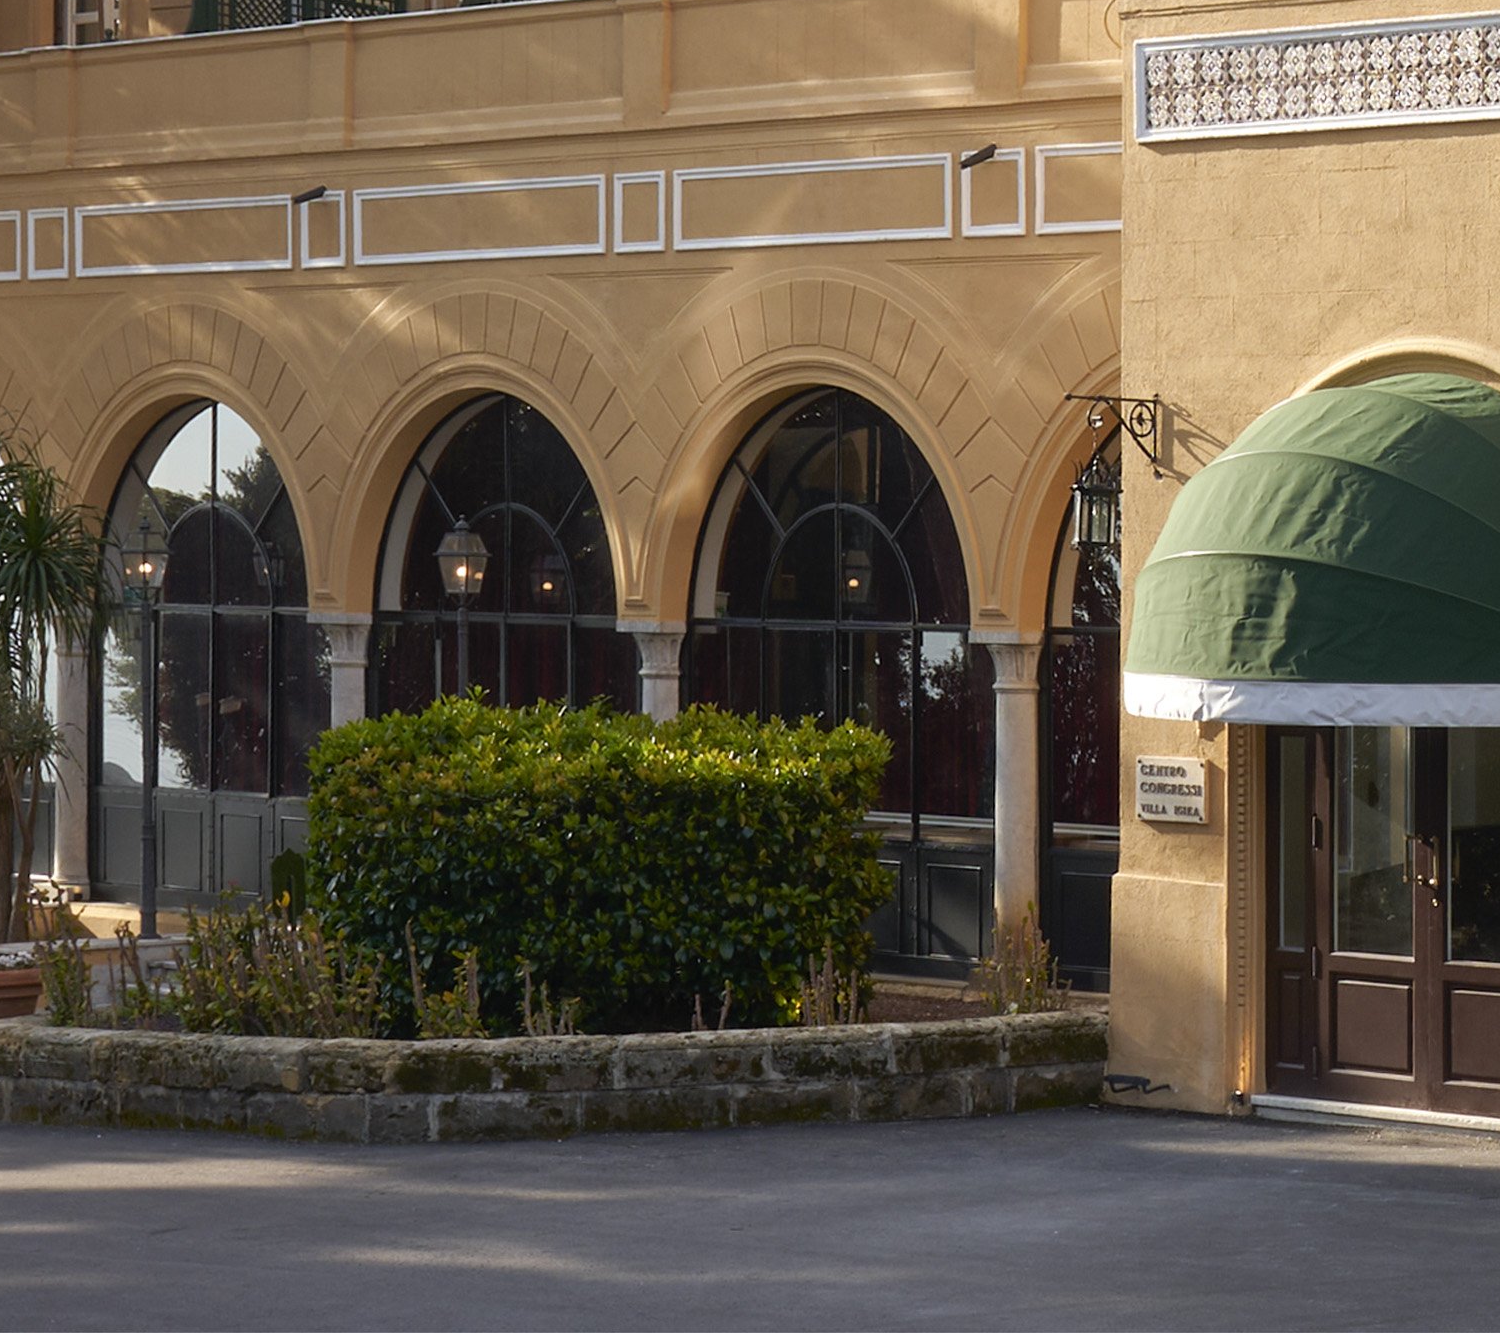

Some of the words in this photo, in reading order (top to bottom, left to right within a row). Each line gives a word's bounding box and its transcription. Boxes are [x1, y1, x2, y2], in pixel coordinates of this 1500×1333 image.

[1140, 764, 1187, 778] CENTRO
[1140, 782, 1203, 796] CONGRESSI
[1141, 803, 1168, 814] VILLA
